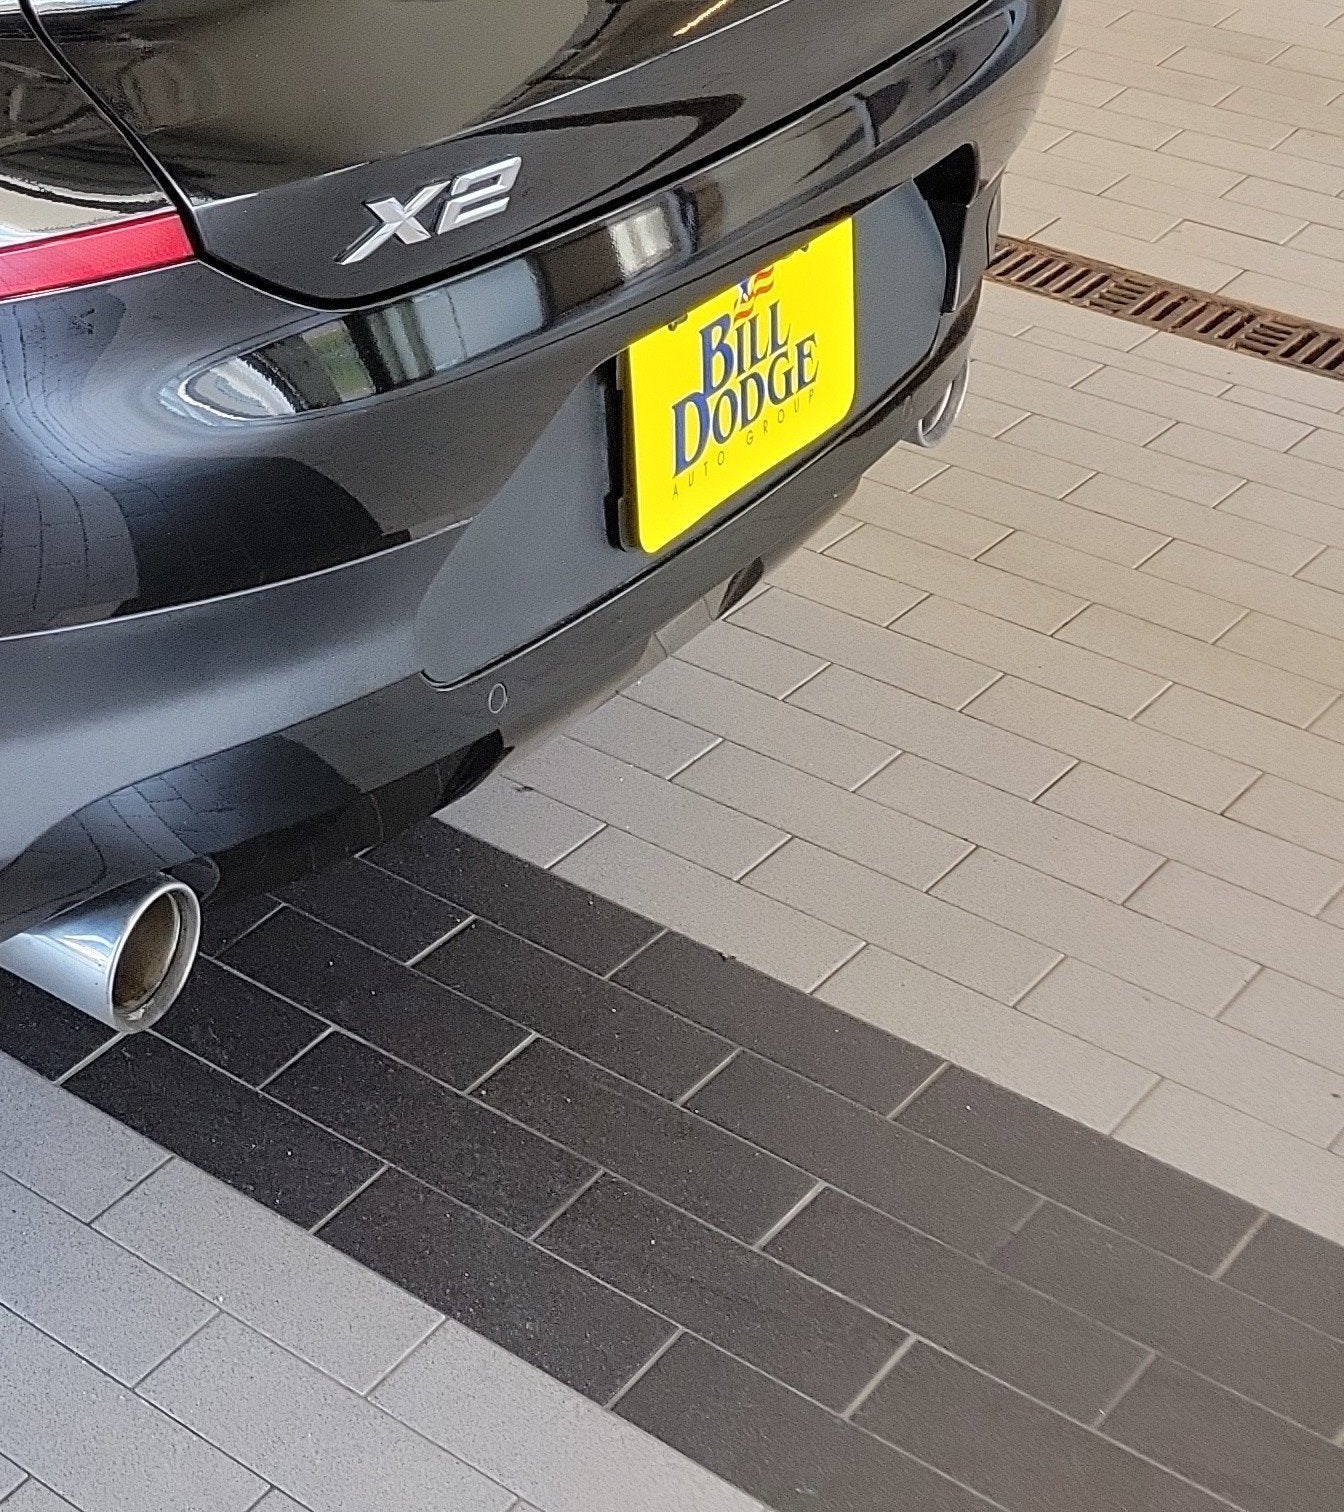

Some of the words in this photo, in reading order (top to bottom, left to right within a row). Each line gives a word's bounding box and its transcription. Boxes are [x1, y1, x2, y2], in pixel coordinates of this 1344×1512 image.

[334, 154, 522, 266] X2
[698, 299, 792, 395] BILL
[671, 331, 820, 479] DODGE
[672, 450, 726, 501] AUTO
[745, 388, 815, 446] GROUP
